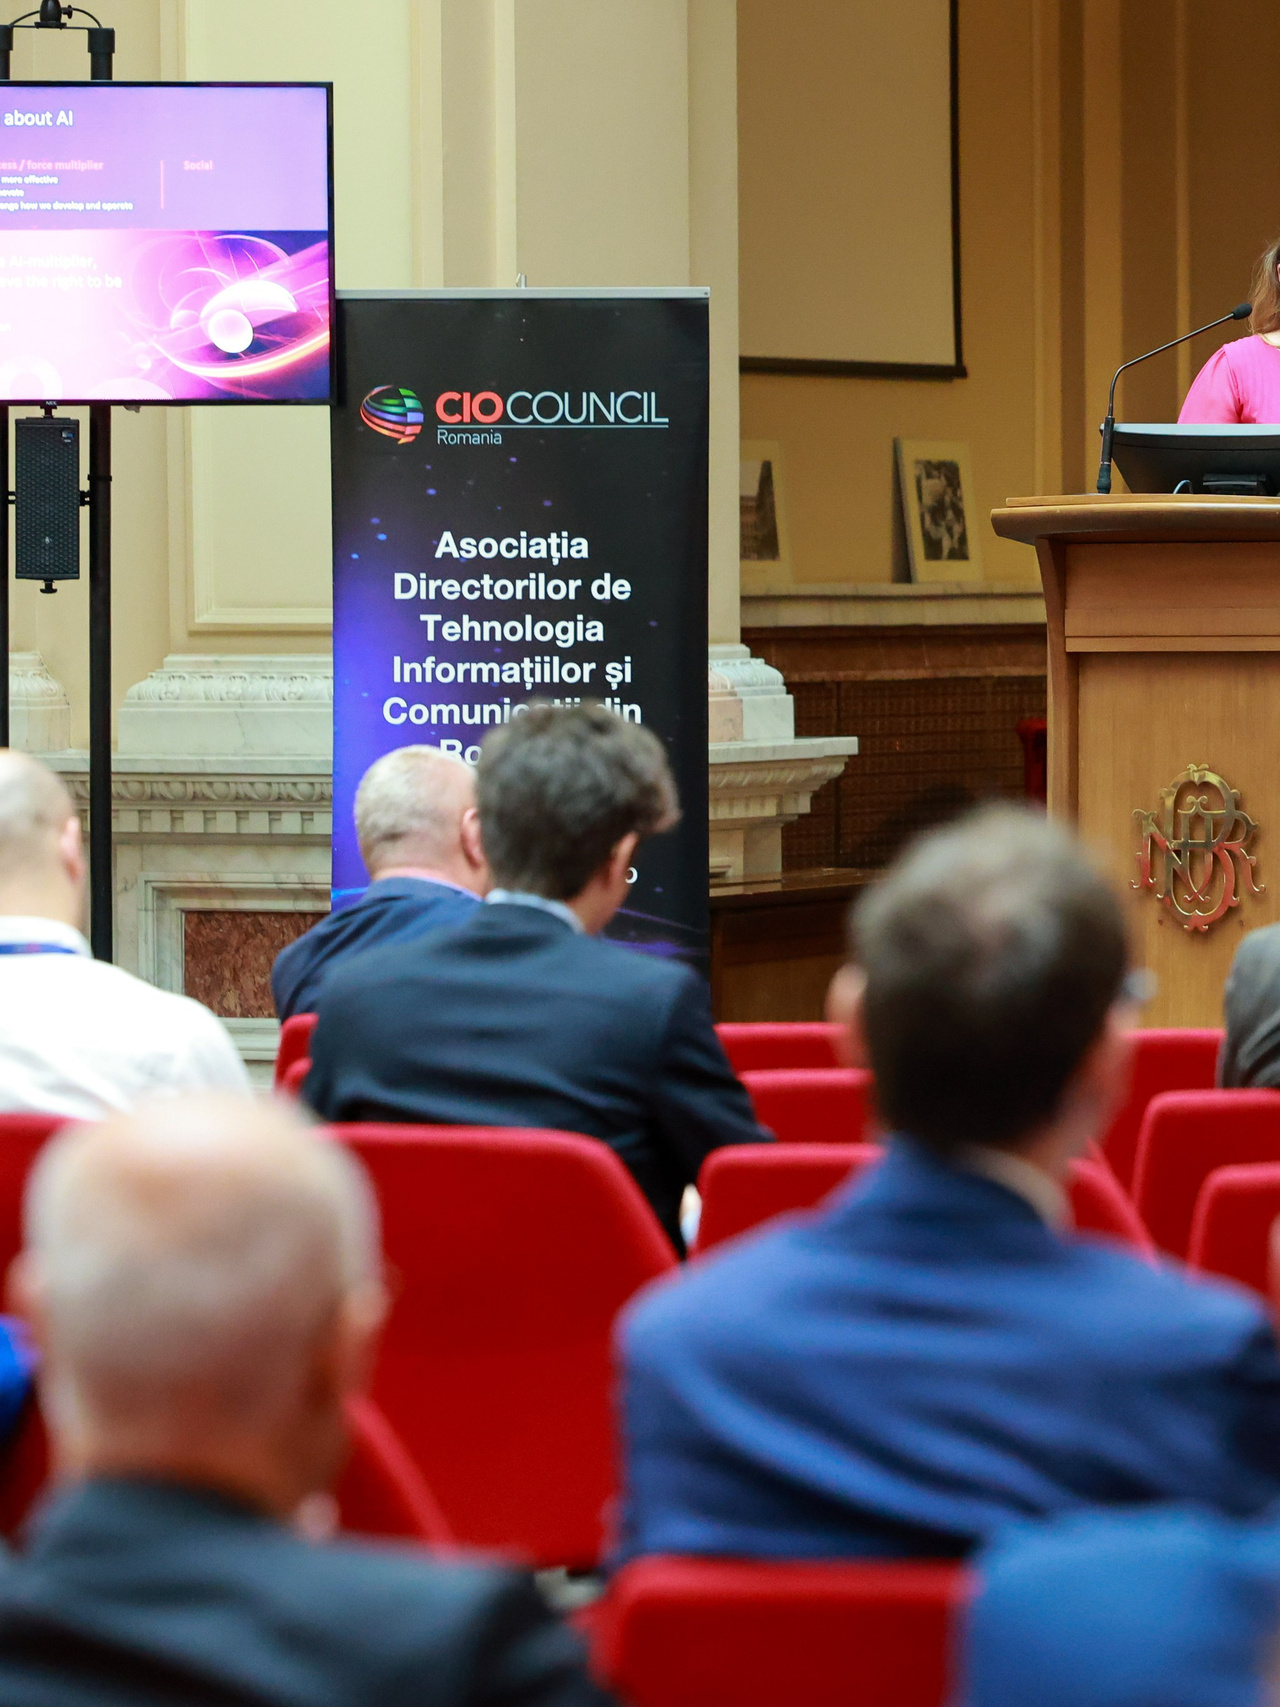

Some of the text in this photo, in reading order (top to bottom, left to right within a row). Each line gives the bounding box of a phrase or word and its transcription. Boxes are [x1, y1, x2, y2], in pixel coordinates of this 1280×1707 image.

[4, 109, 73, 126] about AI
[27, 160, 53, 170] force
[55, 160, 104, 172] multiplier
[183, 160, 213, 170] Social
[24, 174, 59, 184] effective
[20, 200, 38, 210] how
[39, 202, 52, 210] we
[53, 200, 84, 212] develop
[85, 200, 101, 210] and
[102, 202, 133, 212] operate
[0, 273, 123, 291] ave the right to be
[437, 429, 502, 445] Romania
[434, 531, 589, 566] Asociația
[393, 572, 632, 601] Directorilor de
[419, 614, 605, 648] Tehnologia
[393, 655, 632, 690] Informațiilor și
